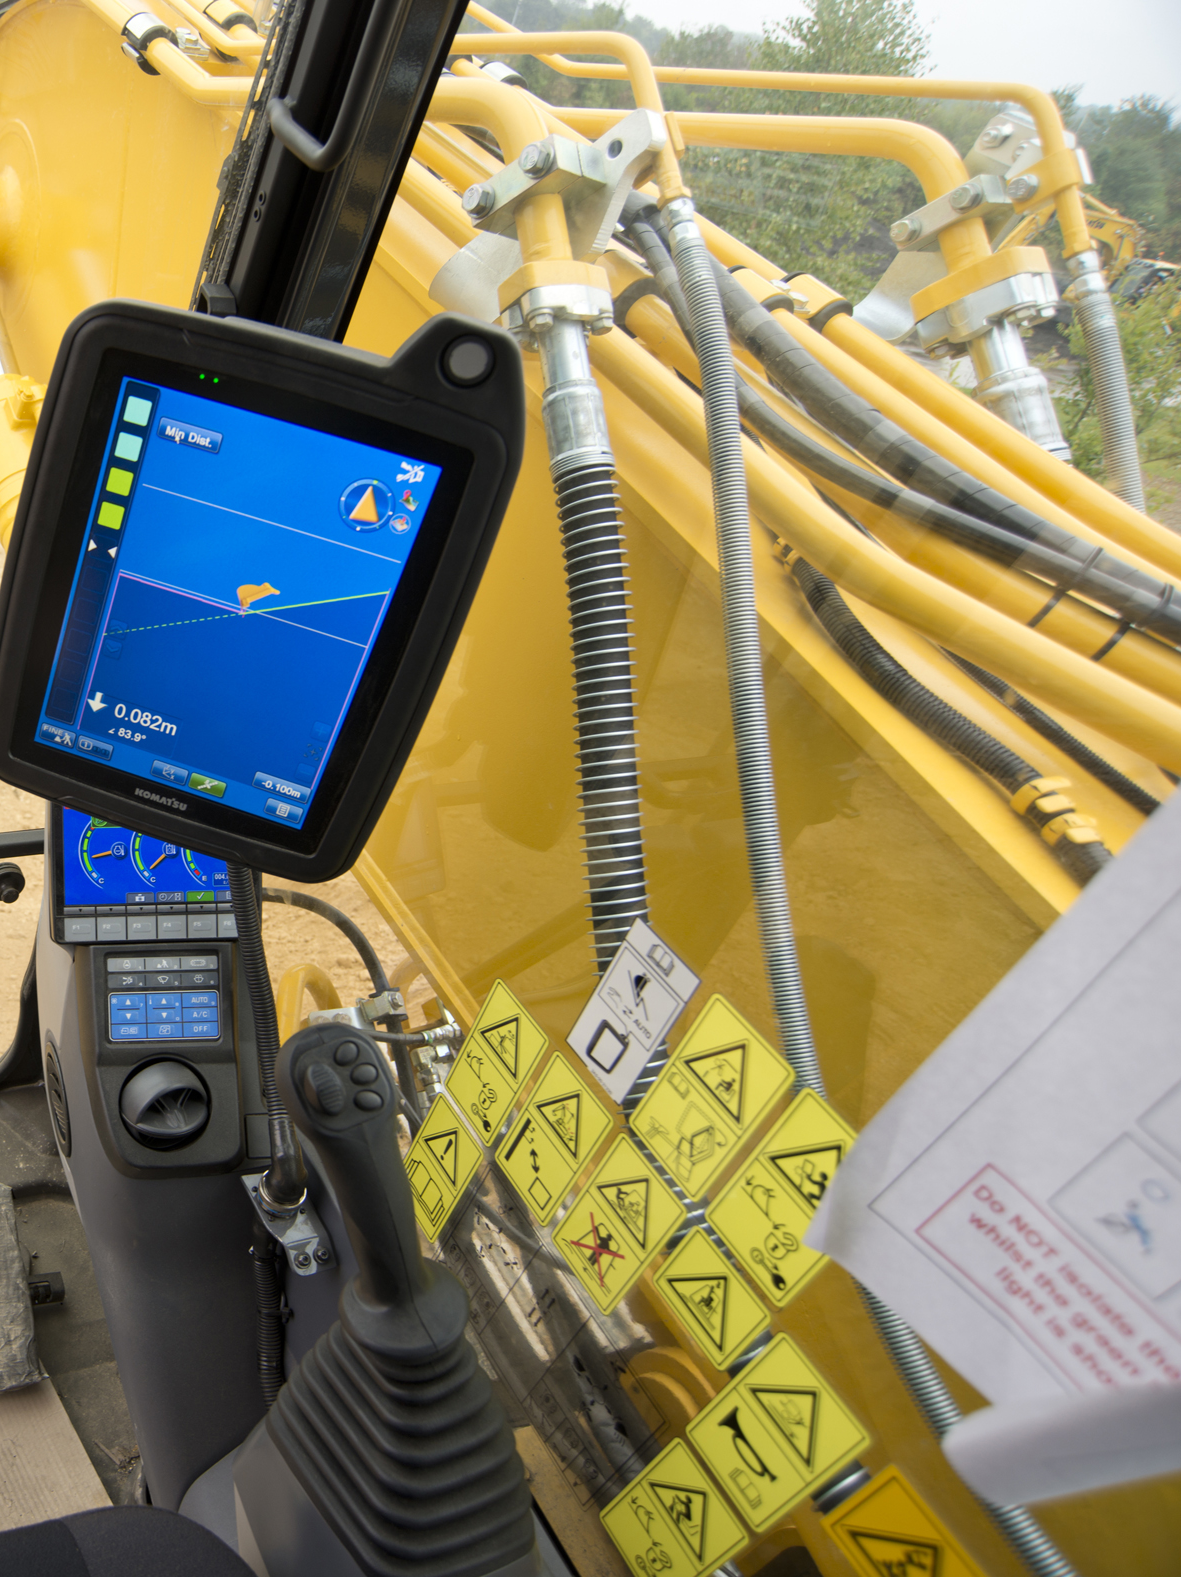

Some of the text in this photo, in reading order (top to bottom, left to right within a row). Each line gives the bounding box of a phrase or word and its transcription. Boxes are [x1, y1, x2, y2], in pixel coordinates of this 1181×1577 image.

[165, 425, 212, 448] Min Dist.
[43, 725, 64, 737] FINE
[114, 703, 177, 736] 0.082m
[117, 727, 147, 742] 83.9°
[134, 787, 188, 811] KOMATSU
[261, 780, 301, 798] -0.100m
[193, 1025, 208, 1033] OFF
[633, 1019, 651, 1039] AUTO
[973, 1184, 1005, 1214] Do
[1009, 1214, 1058, 1259] NOT
[1059, 1264, 1135, 1338] isolate
[969, 1213, 1140, 1377] whilst the green
[996, 1267, 1045, 1315] light
[1046, 1317, 1067, 1338] is
